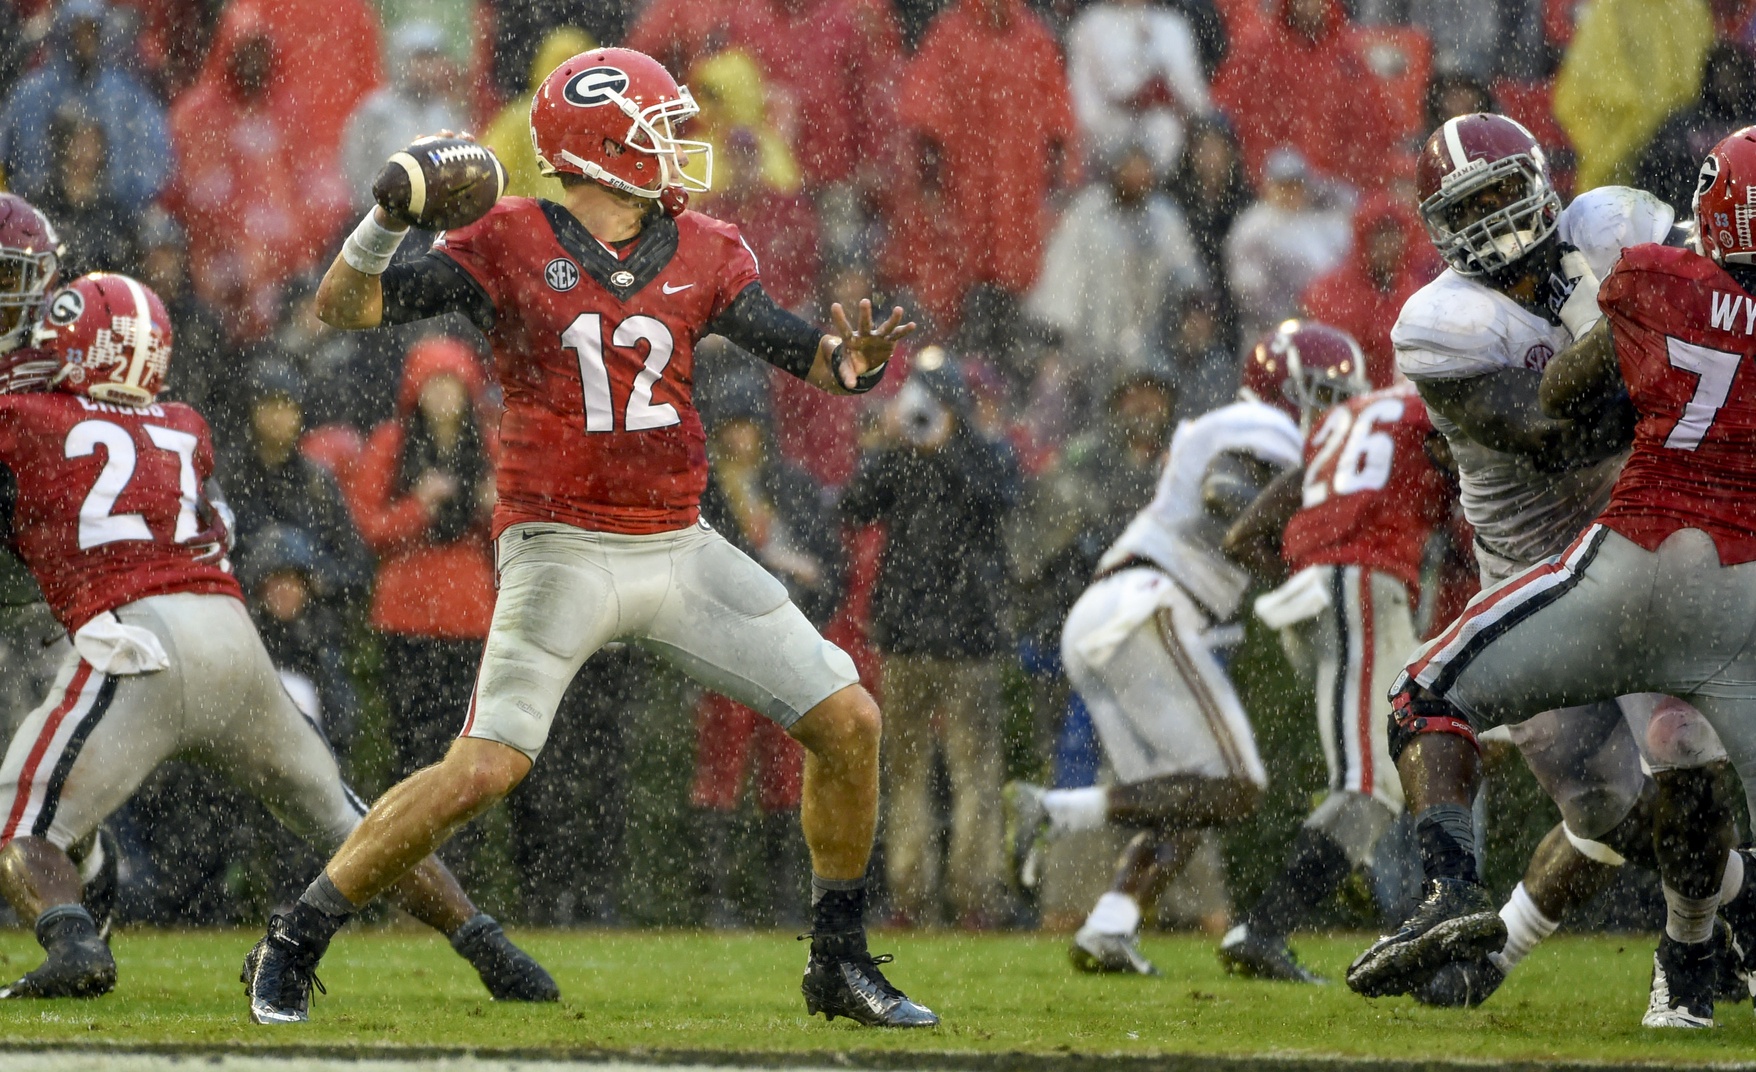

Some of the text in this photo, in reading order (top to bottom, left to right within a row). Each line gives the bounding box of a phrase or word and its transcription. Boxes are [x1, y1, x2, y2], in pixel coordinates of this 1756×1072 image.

[546, 259, 578, 290] SEC
[1714, 212, 1730, 228] 33
[560, 312, 682, 433] 12
[1663, 334, 1743, 452] 7
[64, 420, 198, 551] 27
[1302, 398, 1405, 509] 26
